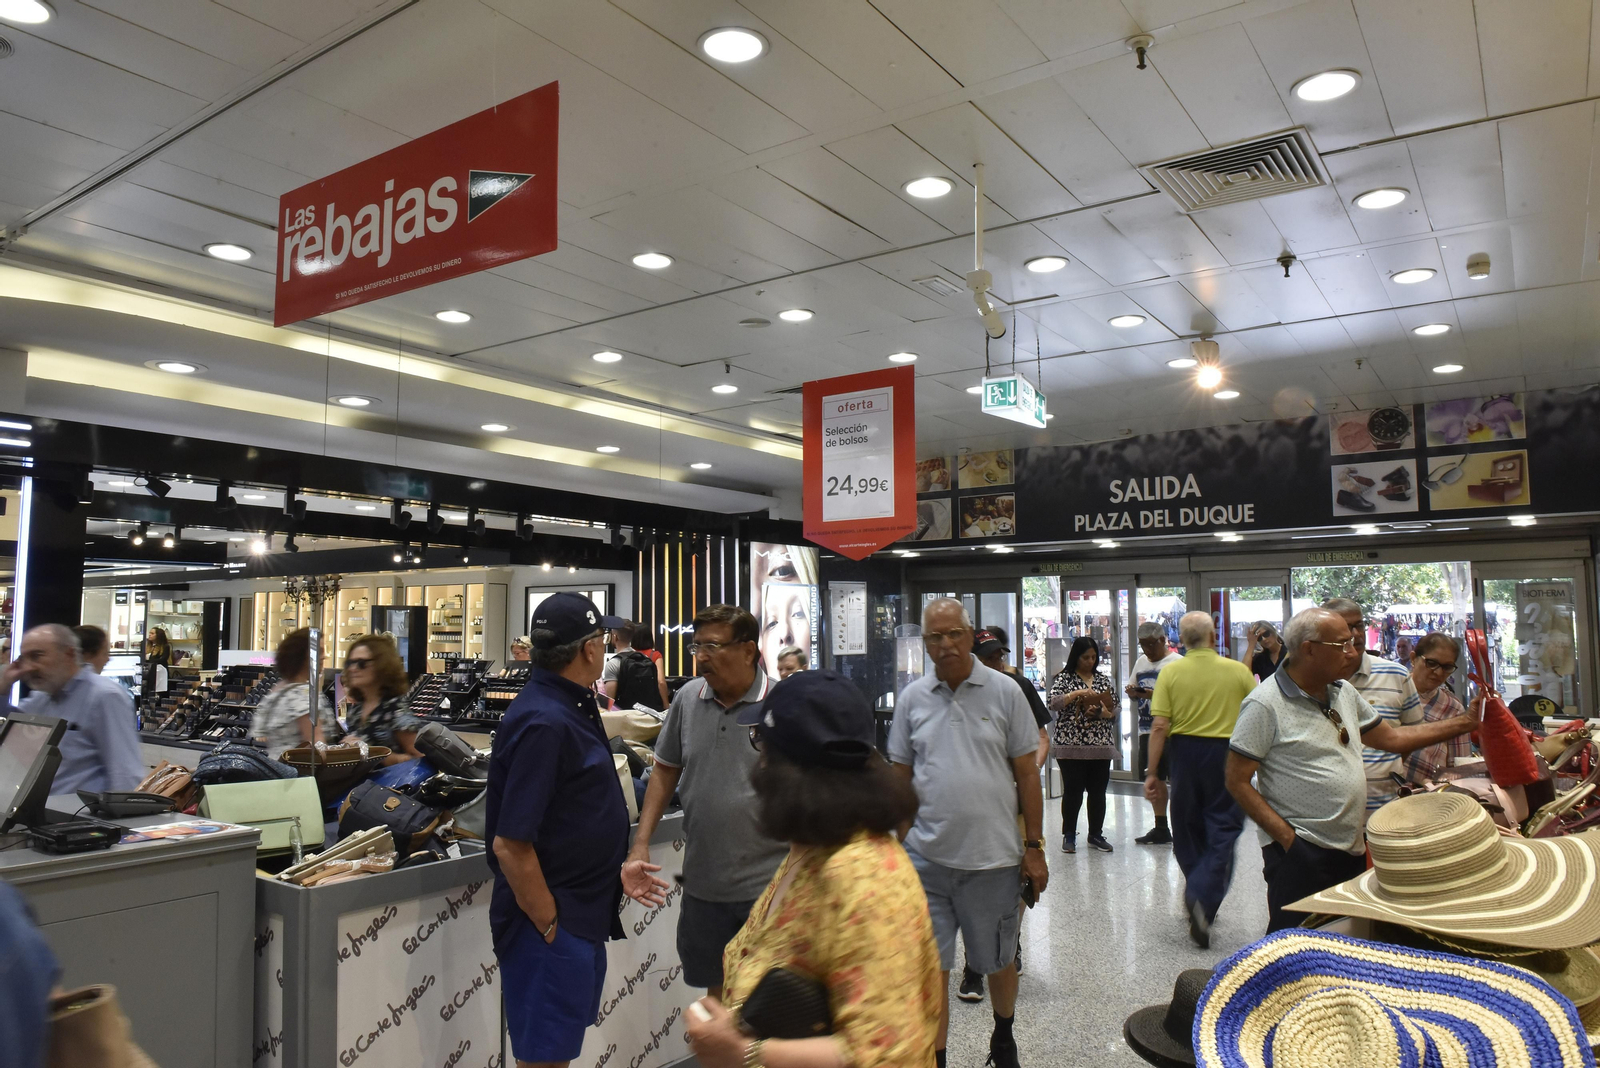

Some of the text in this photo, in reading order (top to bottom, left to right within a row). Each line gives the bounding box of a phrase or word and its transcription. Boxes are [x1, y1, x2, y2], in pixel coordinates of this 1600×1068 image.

[282, 175, 458, 283] rebajas
[285, 204, 316, 234] Las
[347, 286, 364, 296] QUEDA
[363, 277, 393, 291] SATISFECHO
[392, 275, 399, 283] LE
[399, 265, 433, 281] DEVOLVEMOS
[433, 263, 441, 271] SU
[441, 257, 462, 269] DINERO
[837, 400, 873, 413] oferta
[825, 423, 868, 437] Selección
[825, 435, 869, 448] de bolsos
[826, 474, 889, 497] 24,99€
[1109, 473, 1202, 504] SALIDA
[1074, 503, 1255, 532] PLAZA DEL DUQUE
[1307, 552, 1325, 562] SALIDA
[1332, 550, 1364, 562] EMERGENCIA
[1522, 589, 1566, 598] BIOTHERM
[585, 610, 597, 625] 3
[346, 905, 398, 957] Inglés
[416, 911, 450, 942] Corte
[453, 976, 485, 1009] Corte
[603, 986, 628, 1016] Corte
[623, 952, 657, 995] Inglés
[355, 1017, 393, 1053] Corte
[386, 974, 436, 1027] Inglés
[650, 1006, 681, 1050] Inglés
